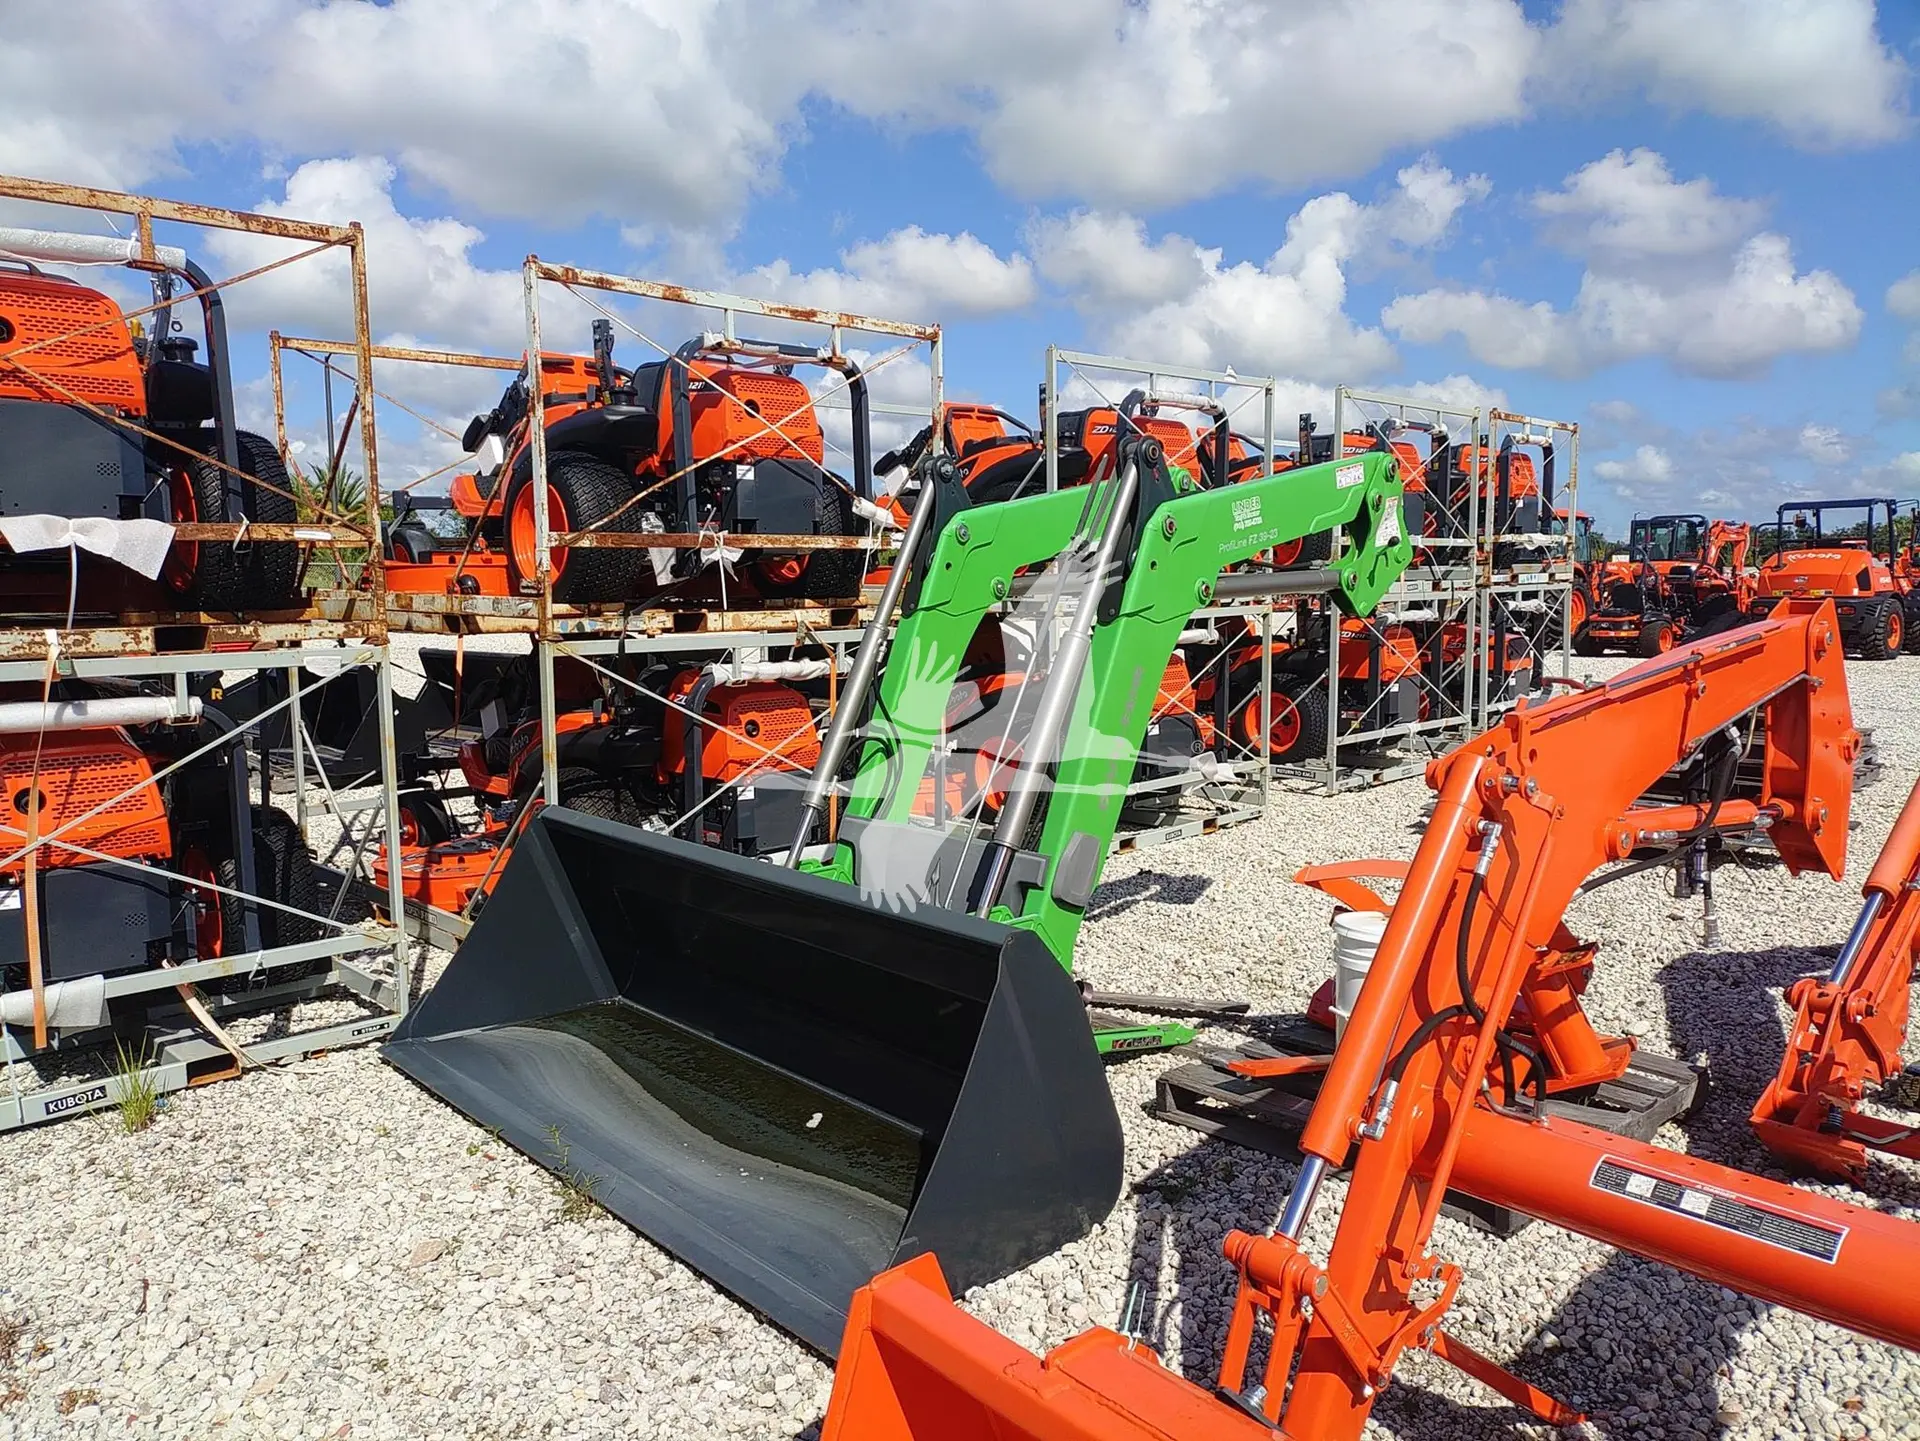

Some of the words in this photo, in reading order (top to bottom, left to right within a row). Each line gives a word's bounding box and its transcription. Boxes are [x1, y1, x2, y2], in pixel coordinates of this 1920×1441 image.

[1218, 538, 1248, 554] ProfiLine
[1248, 533, 1258, 545] FZ
[1787, 552, 1842, 563] Kubota
[48, 1088, 104, 1113] KUBOTA
